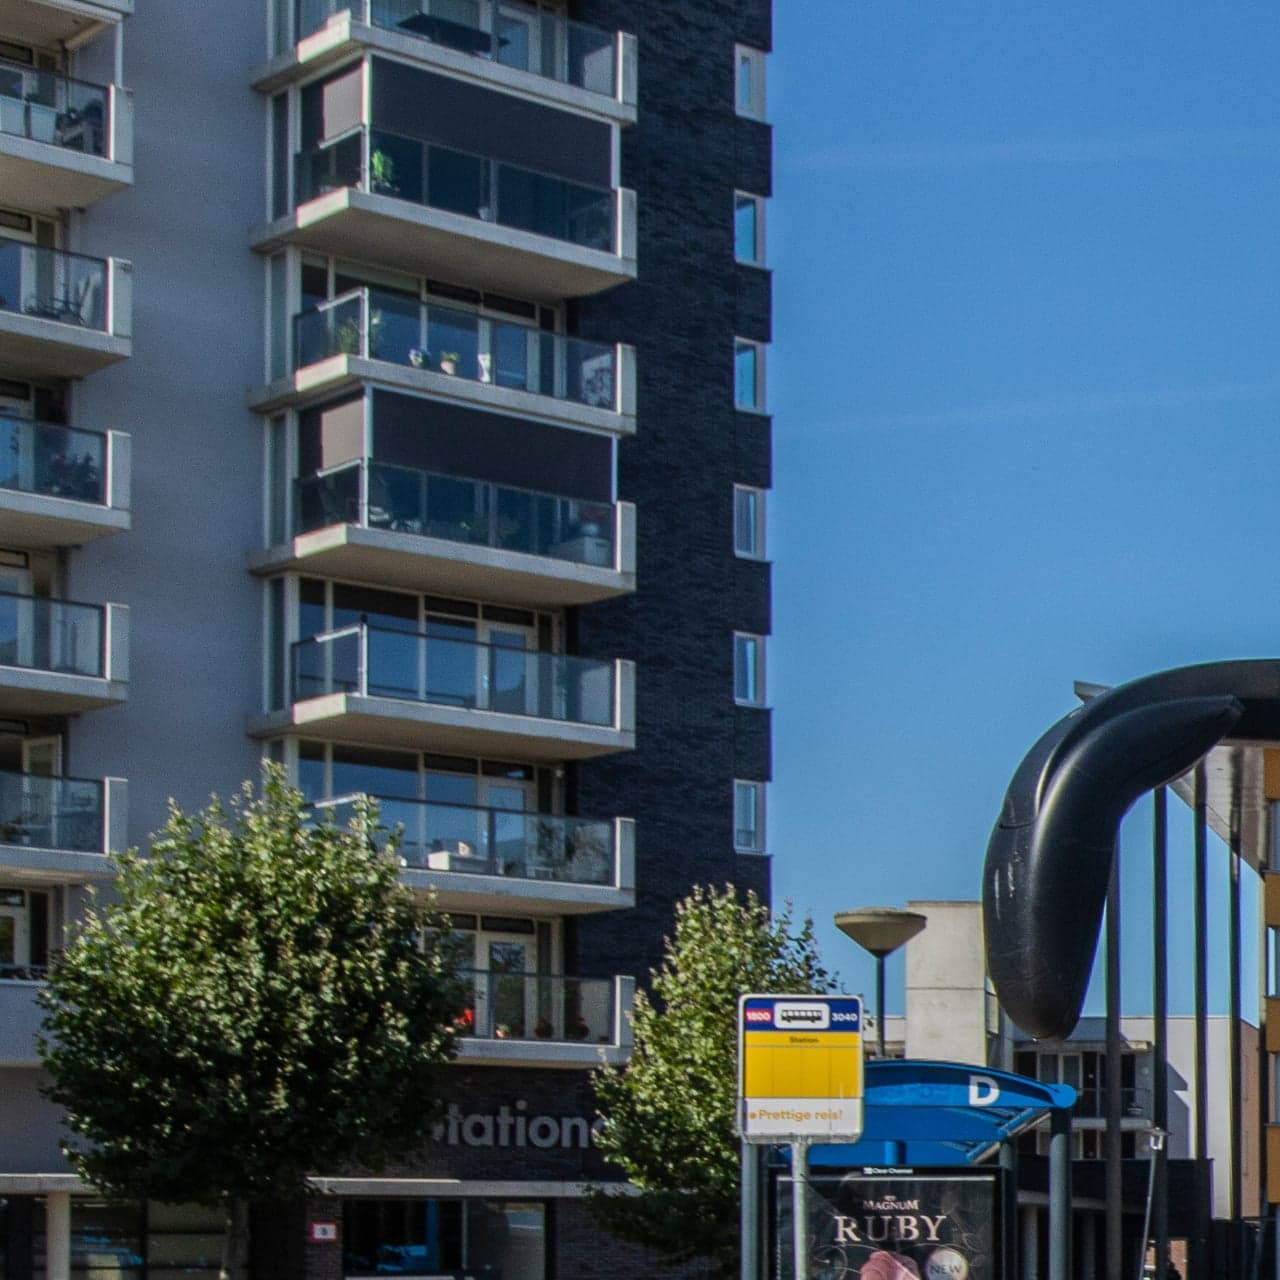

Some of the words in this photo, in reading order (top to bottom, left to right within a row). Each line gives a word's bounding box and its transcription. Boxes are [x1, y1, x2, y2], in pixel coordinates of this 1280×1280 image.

[831, 1011, 858, 1022] 3040
[968, 1074, 1000, 1107] D
[758, 1109, 811, 1123] Prettige
[863, 1199, 921, 1211] MAGNUM
[833, 1215, 948, 1242] RUBY
[930, 1264, 963, 1275] NEW
